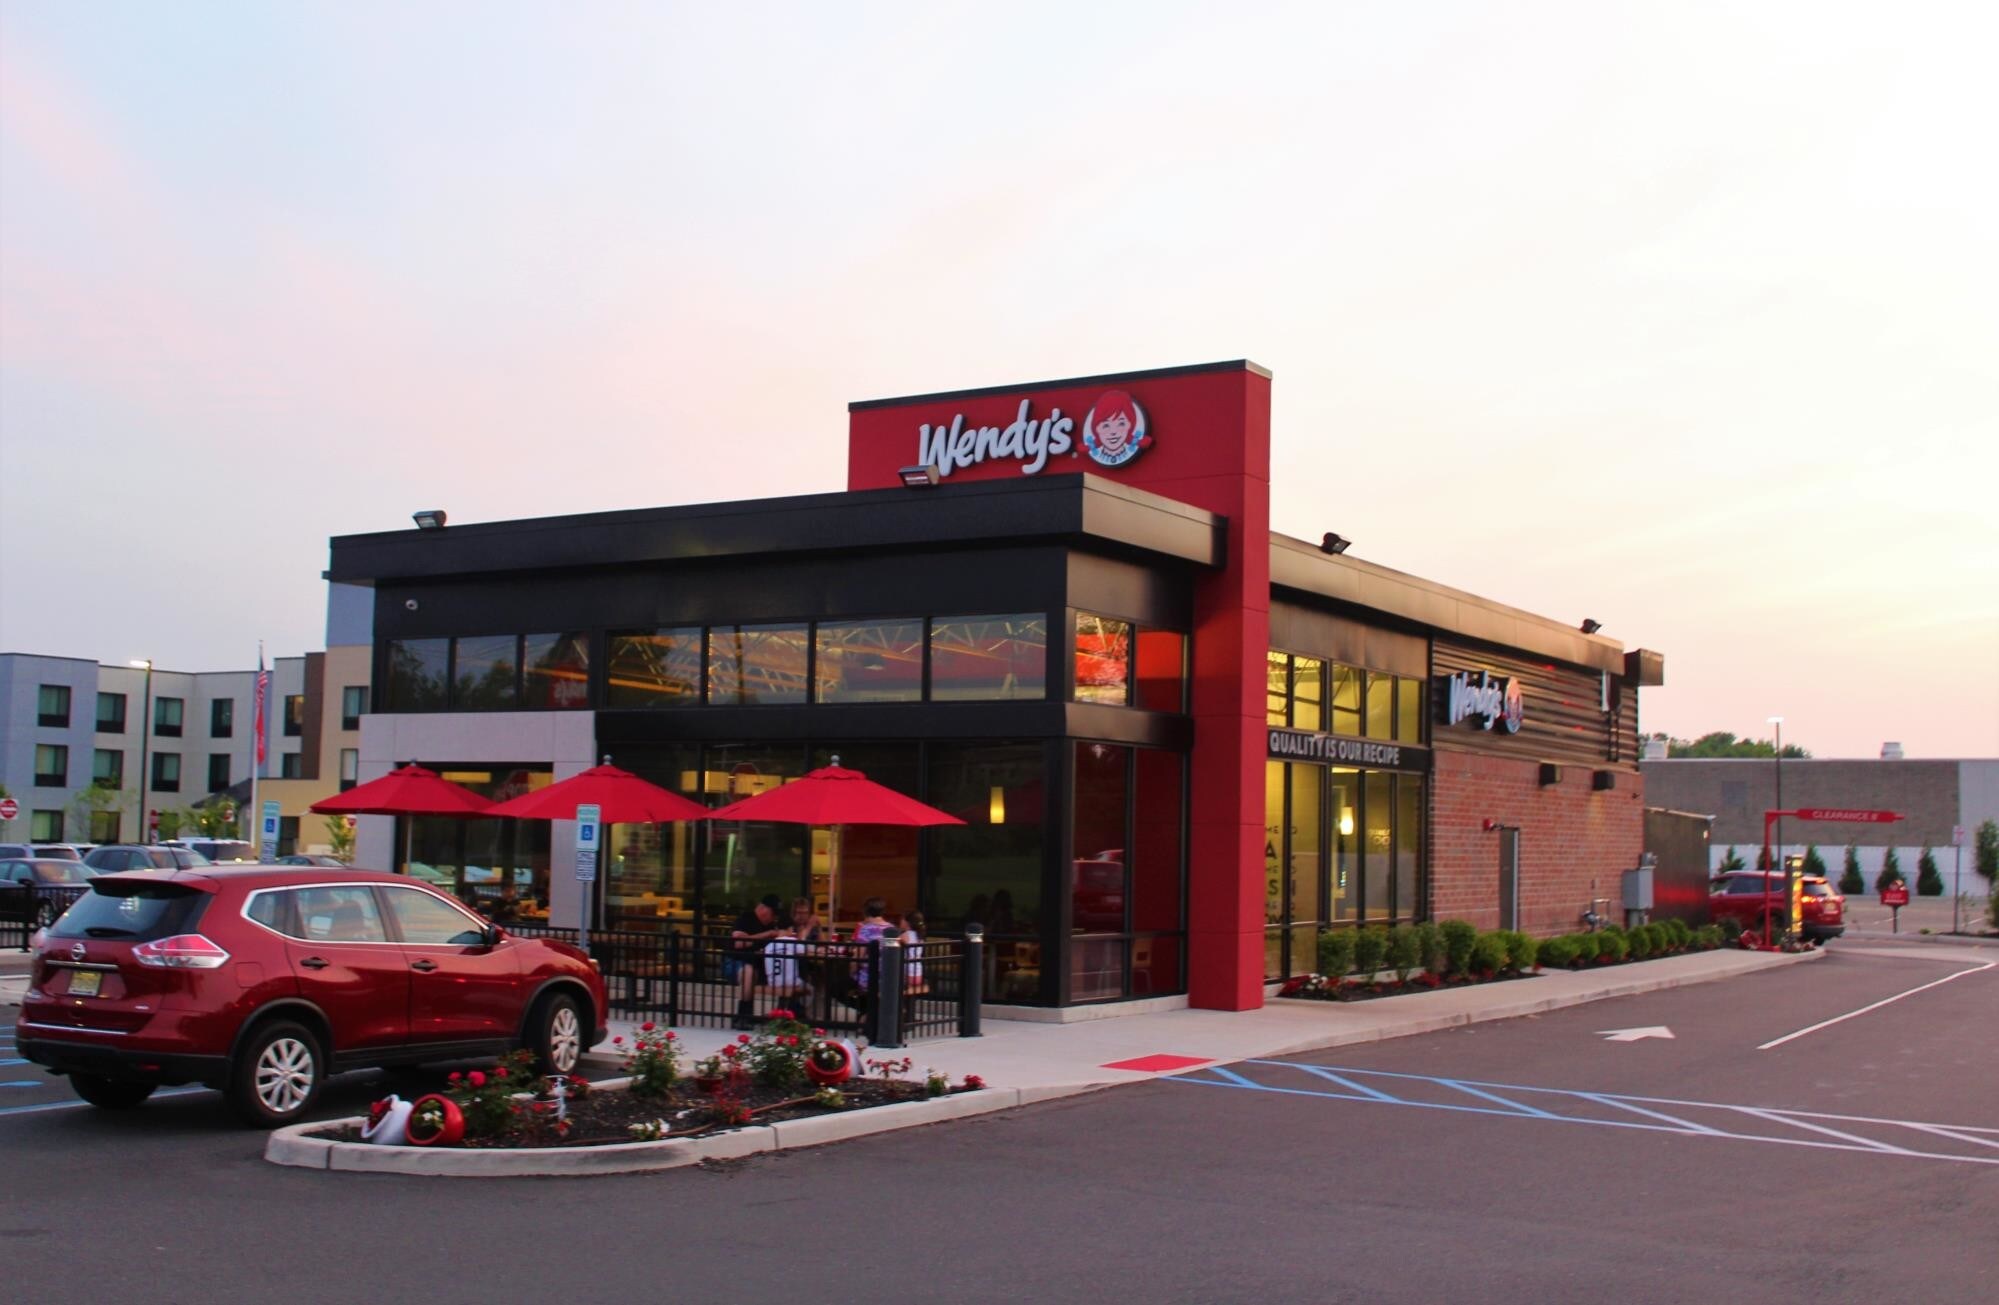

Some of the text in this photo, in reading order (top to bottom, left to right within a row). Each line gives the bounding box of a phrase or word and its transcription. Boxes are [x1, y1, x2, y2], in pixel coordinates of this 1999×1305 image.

[919, 399, 1074, 477] Wendy's
[1449, 670, 1503, 730] Wendy's
[1269, 732, 1400, 765] QUALITY IS OUR RECIPE
